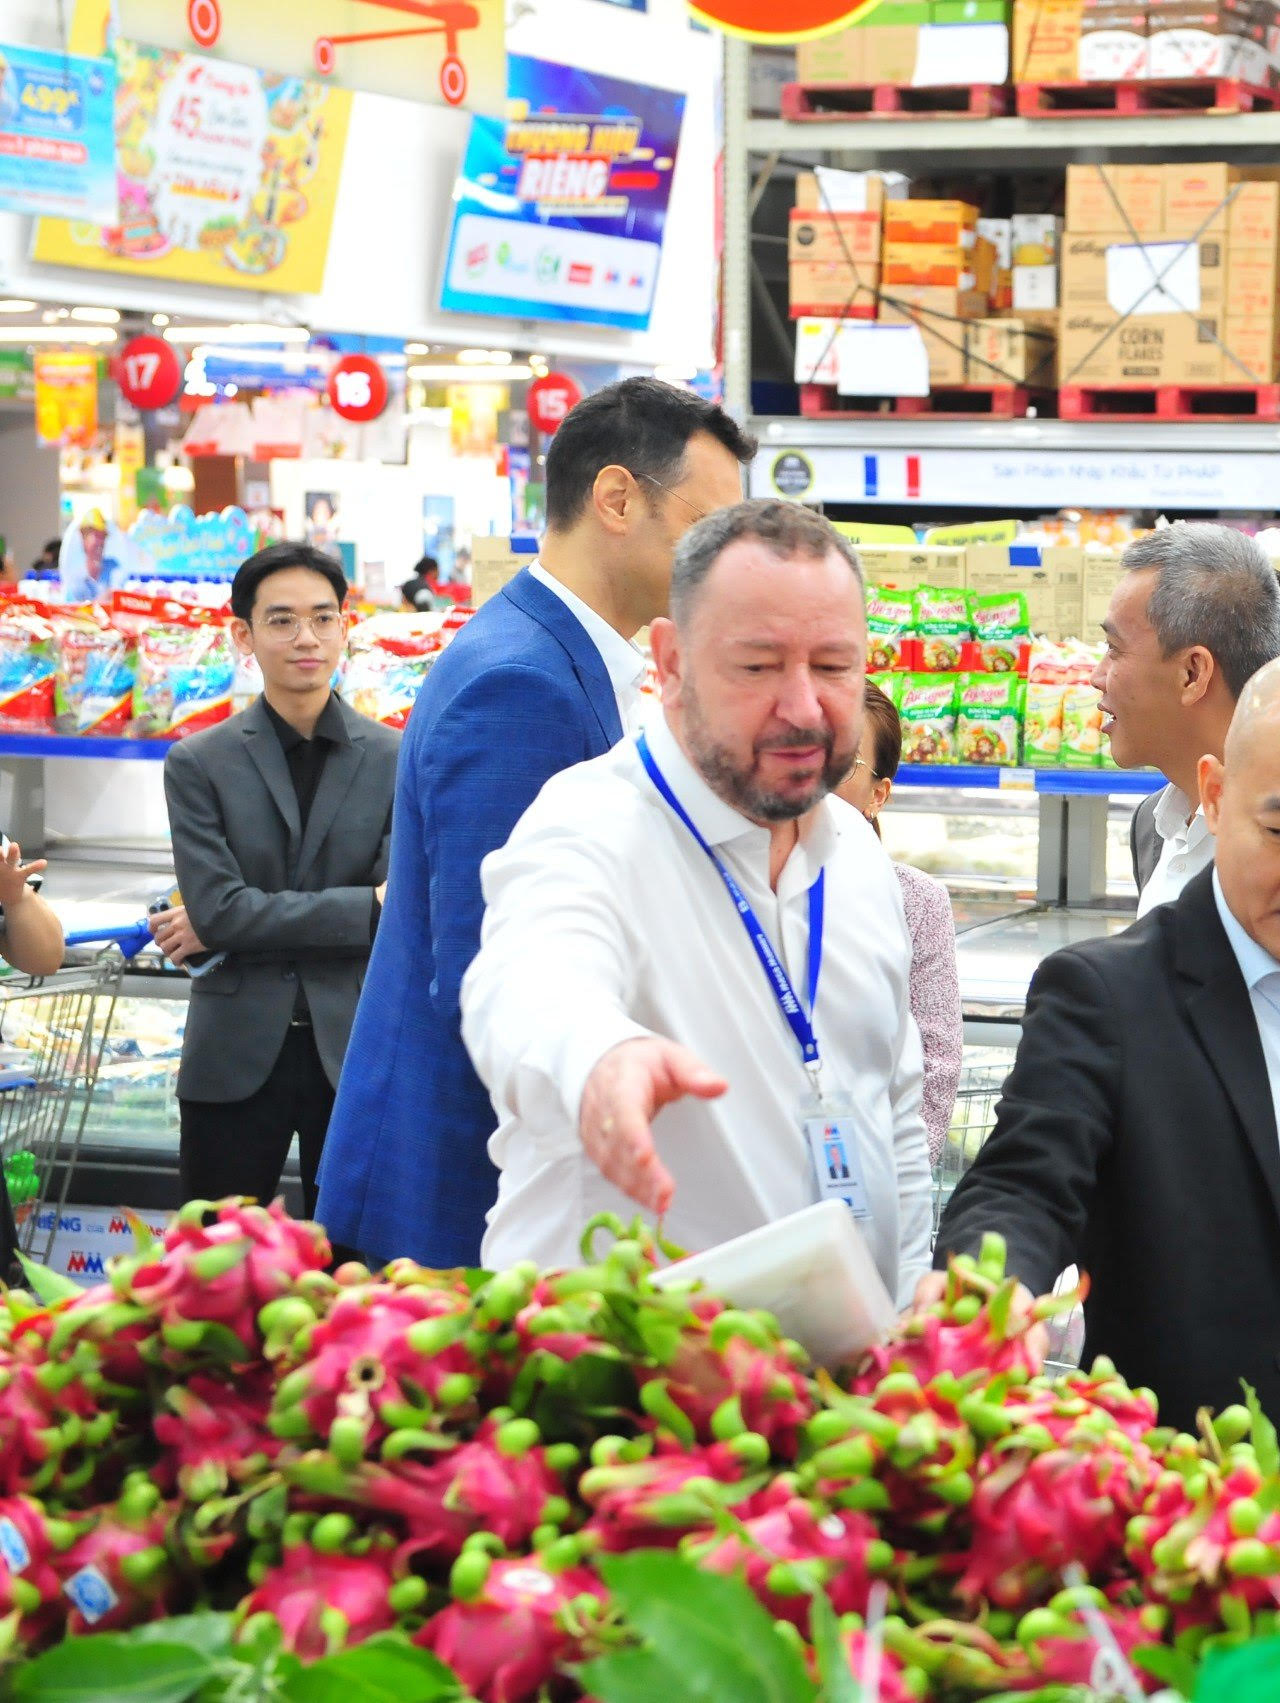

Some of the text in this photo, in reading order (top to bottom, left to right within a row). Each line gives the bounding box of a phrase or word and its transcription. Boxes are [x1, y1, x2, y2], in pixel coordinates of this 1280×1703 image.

[1119, 328, 1164, 345] CORN
[125, 354, 160, 391] 17
[536, 389, 568, 419] 15
[36, 1211, 82, 1232] IÊNG
[67, 1251, 104, 1274] MM
